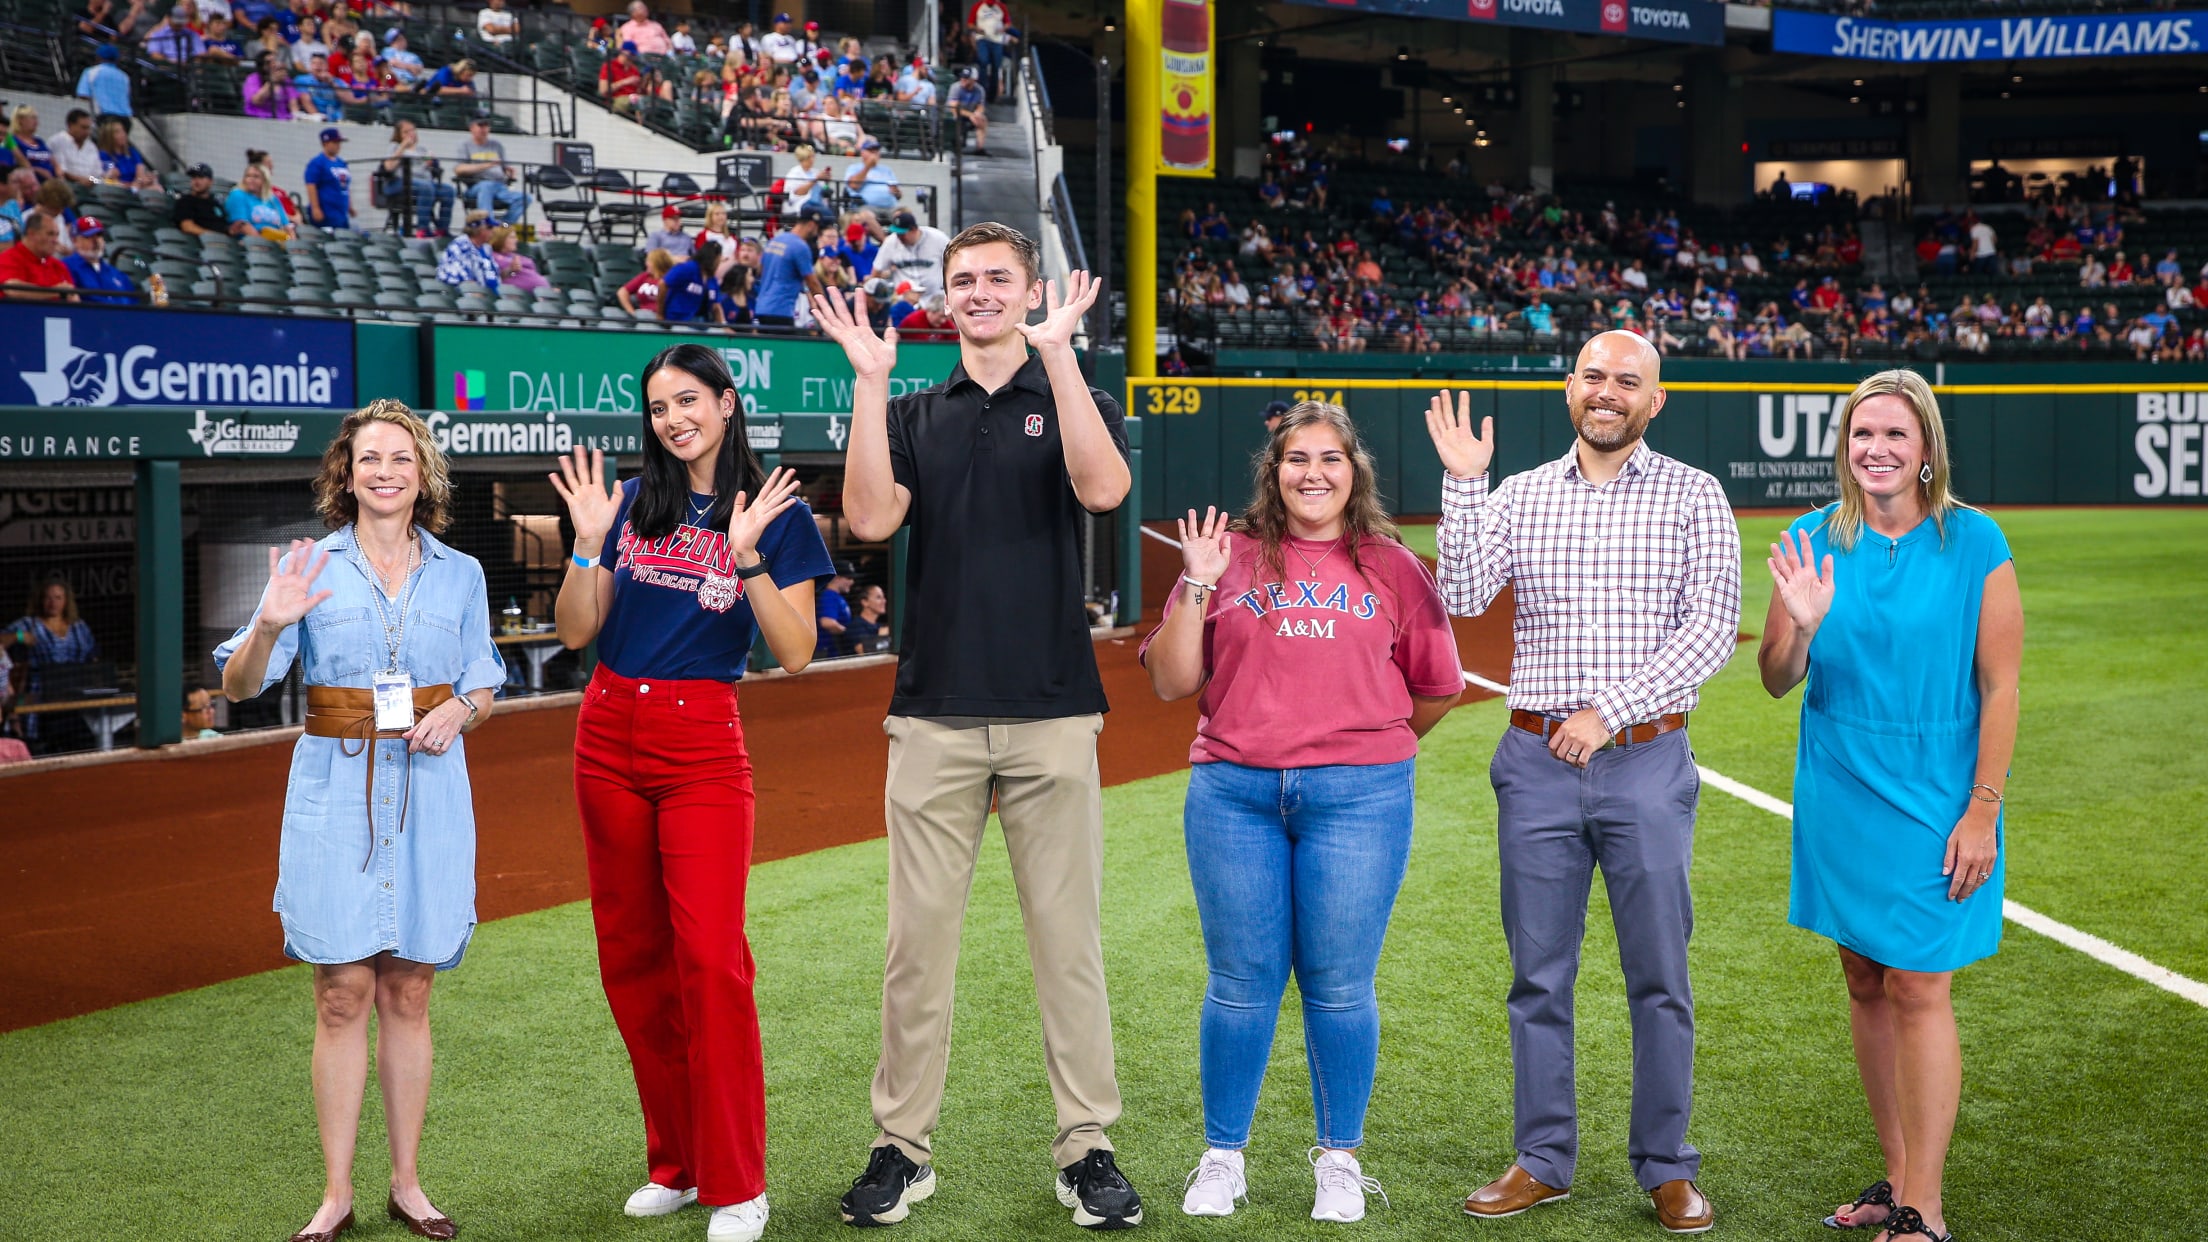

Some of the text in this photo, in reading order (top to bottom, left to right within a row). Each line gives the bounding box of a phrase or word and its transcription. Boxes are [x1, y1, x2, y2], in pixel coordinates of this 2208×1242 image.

[1630, 6, 1690, 29] TOYOTA
[120, 344, 331, 404] Germania
[509, 371, 636, 413] DALLAS
[802, 377, 827, 408] FT
[1147, 387, 1201, 414] 329
[221, 419, 299, 439] Germania
[428, 411, 572, 453] Germania
[0, 436, 140, 456] SURANCE
[1729, 461, 1833, 478] THE UNIVERSITY
[1765, 481, 1785, 498] AT
[29, 519, 133, 542] INSURA
[1234, 580, 1380, 620] TEXAS
[1276, 617, 1337, 639] A&M
